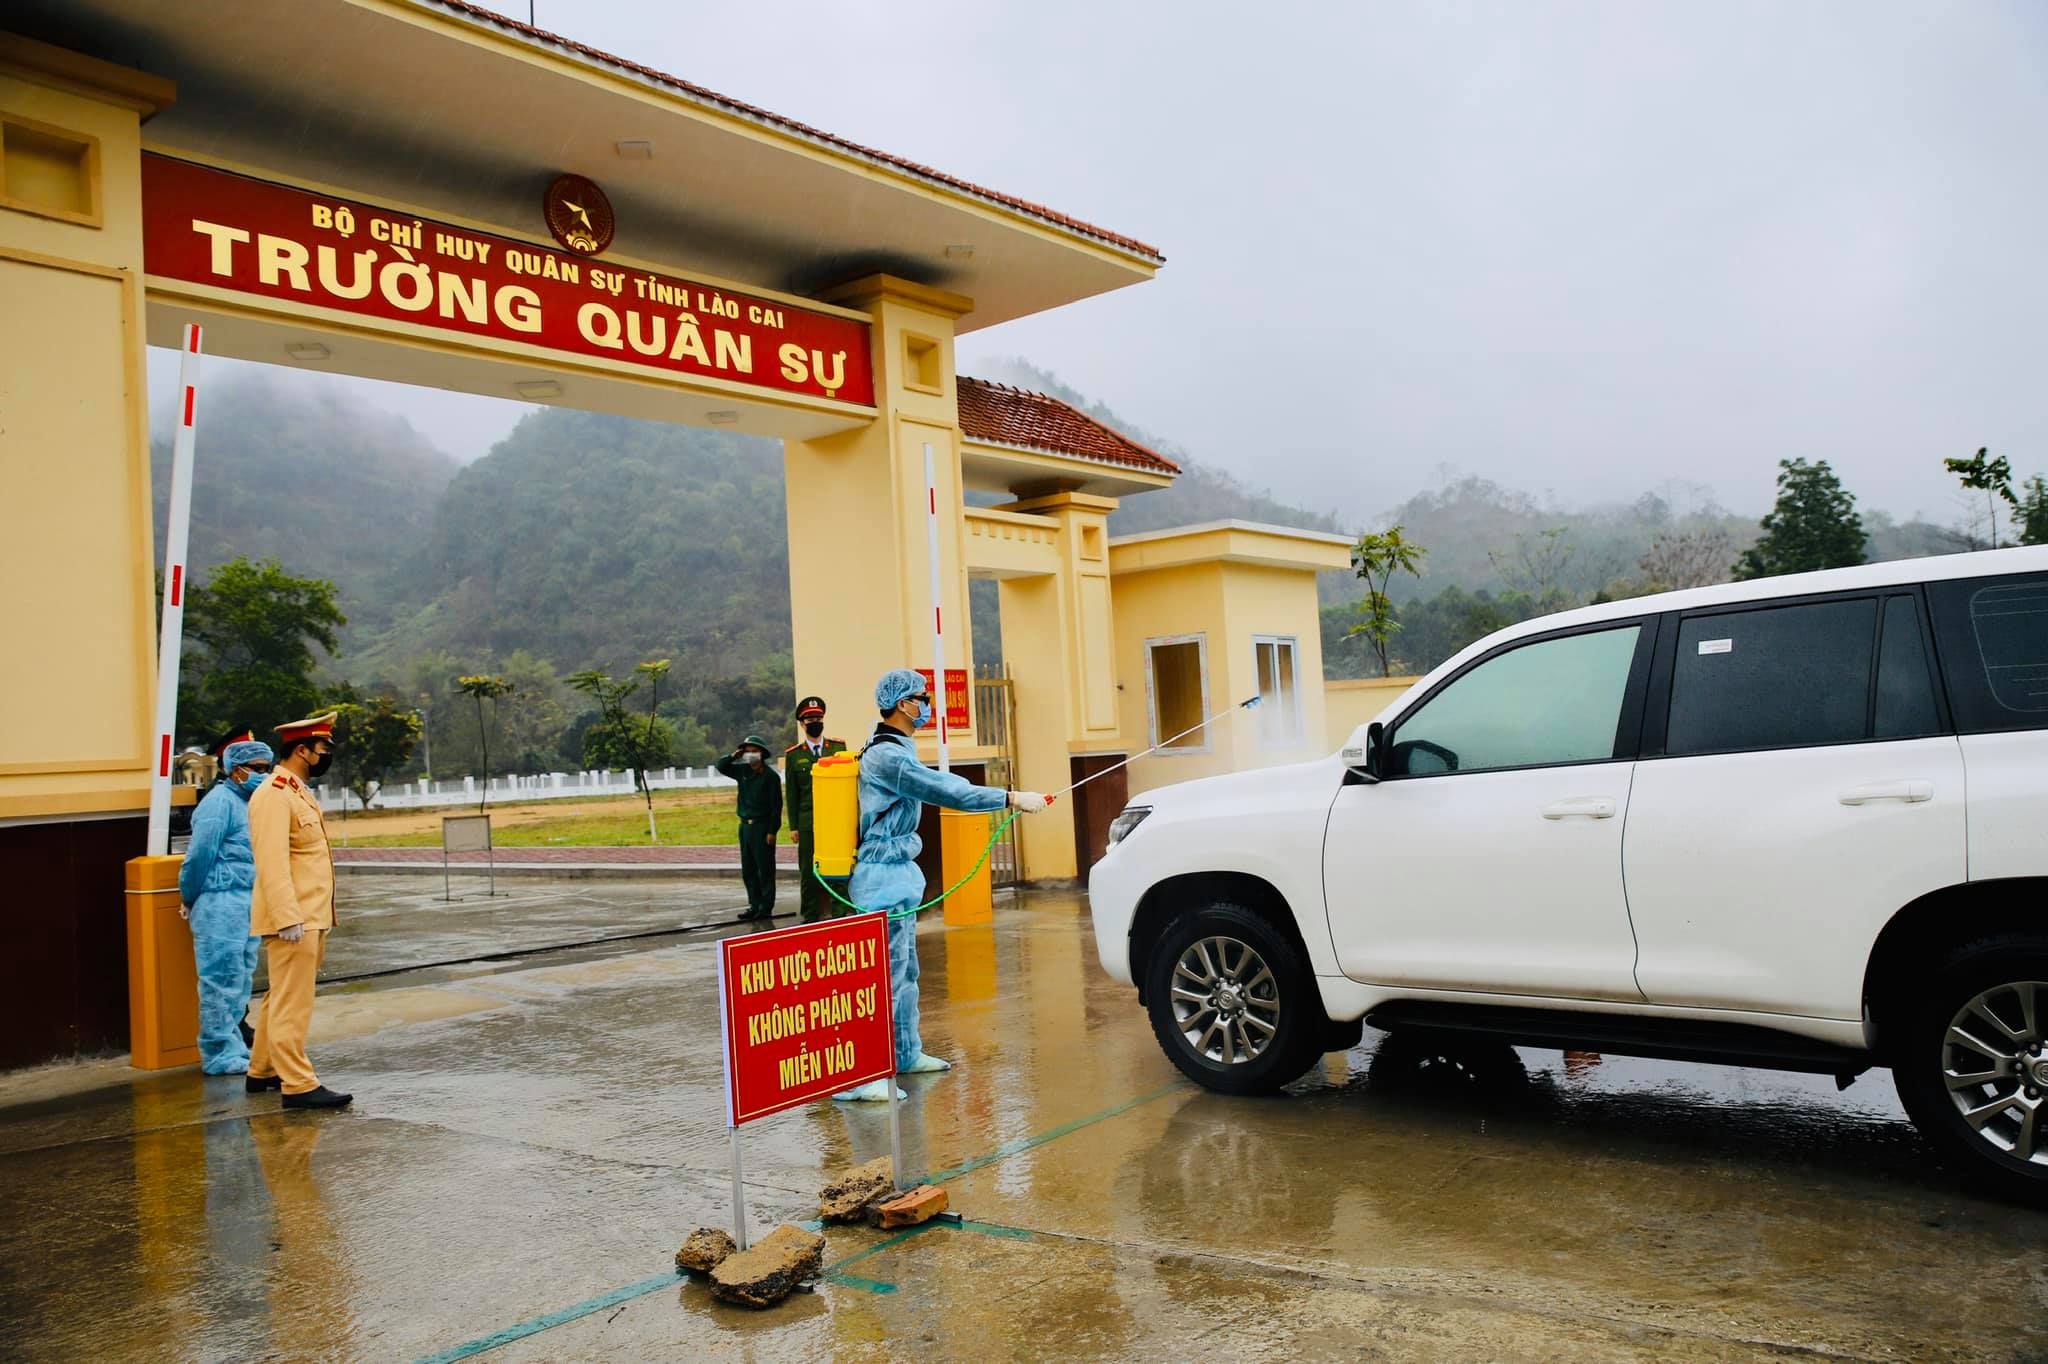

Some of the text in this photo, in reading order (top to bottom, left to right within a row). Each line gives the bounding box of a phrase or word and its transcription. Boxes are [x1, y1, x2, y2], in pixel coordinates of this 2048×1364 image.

[311, 204, 784, 329] BỘ CHỈ HUY QUÂN SỰ TỈNH LÀO CAI
[192, 219, 847, 398] TRƯỜNG QUÂN SỰ
[740, 938, 877, 996] KHU VỰC CÁCH LY
[748, 983, 877, 1047] KHÔNG PHẬN SỰ
[779, 1038, 855, 1091] MIỄN VÀO
